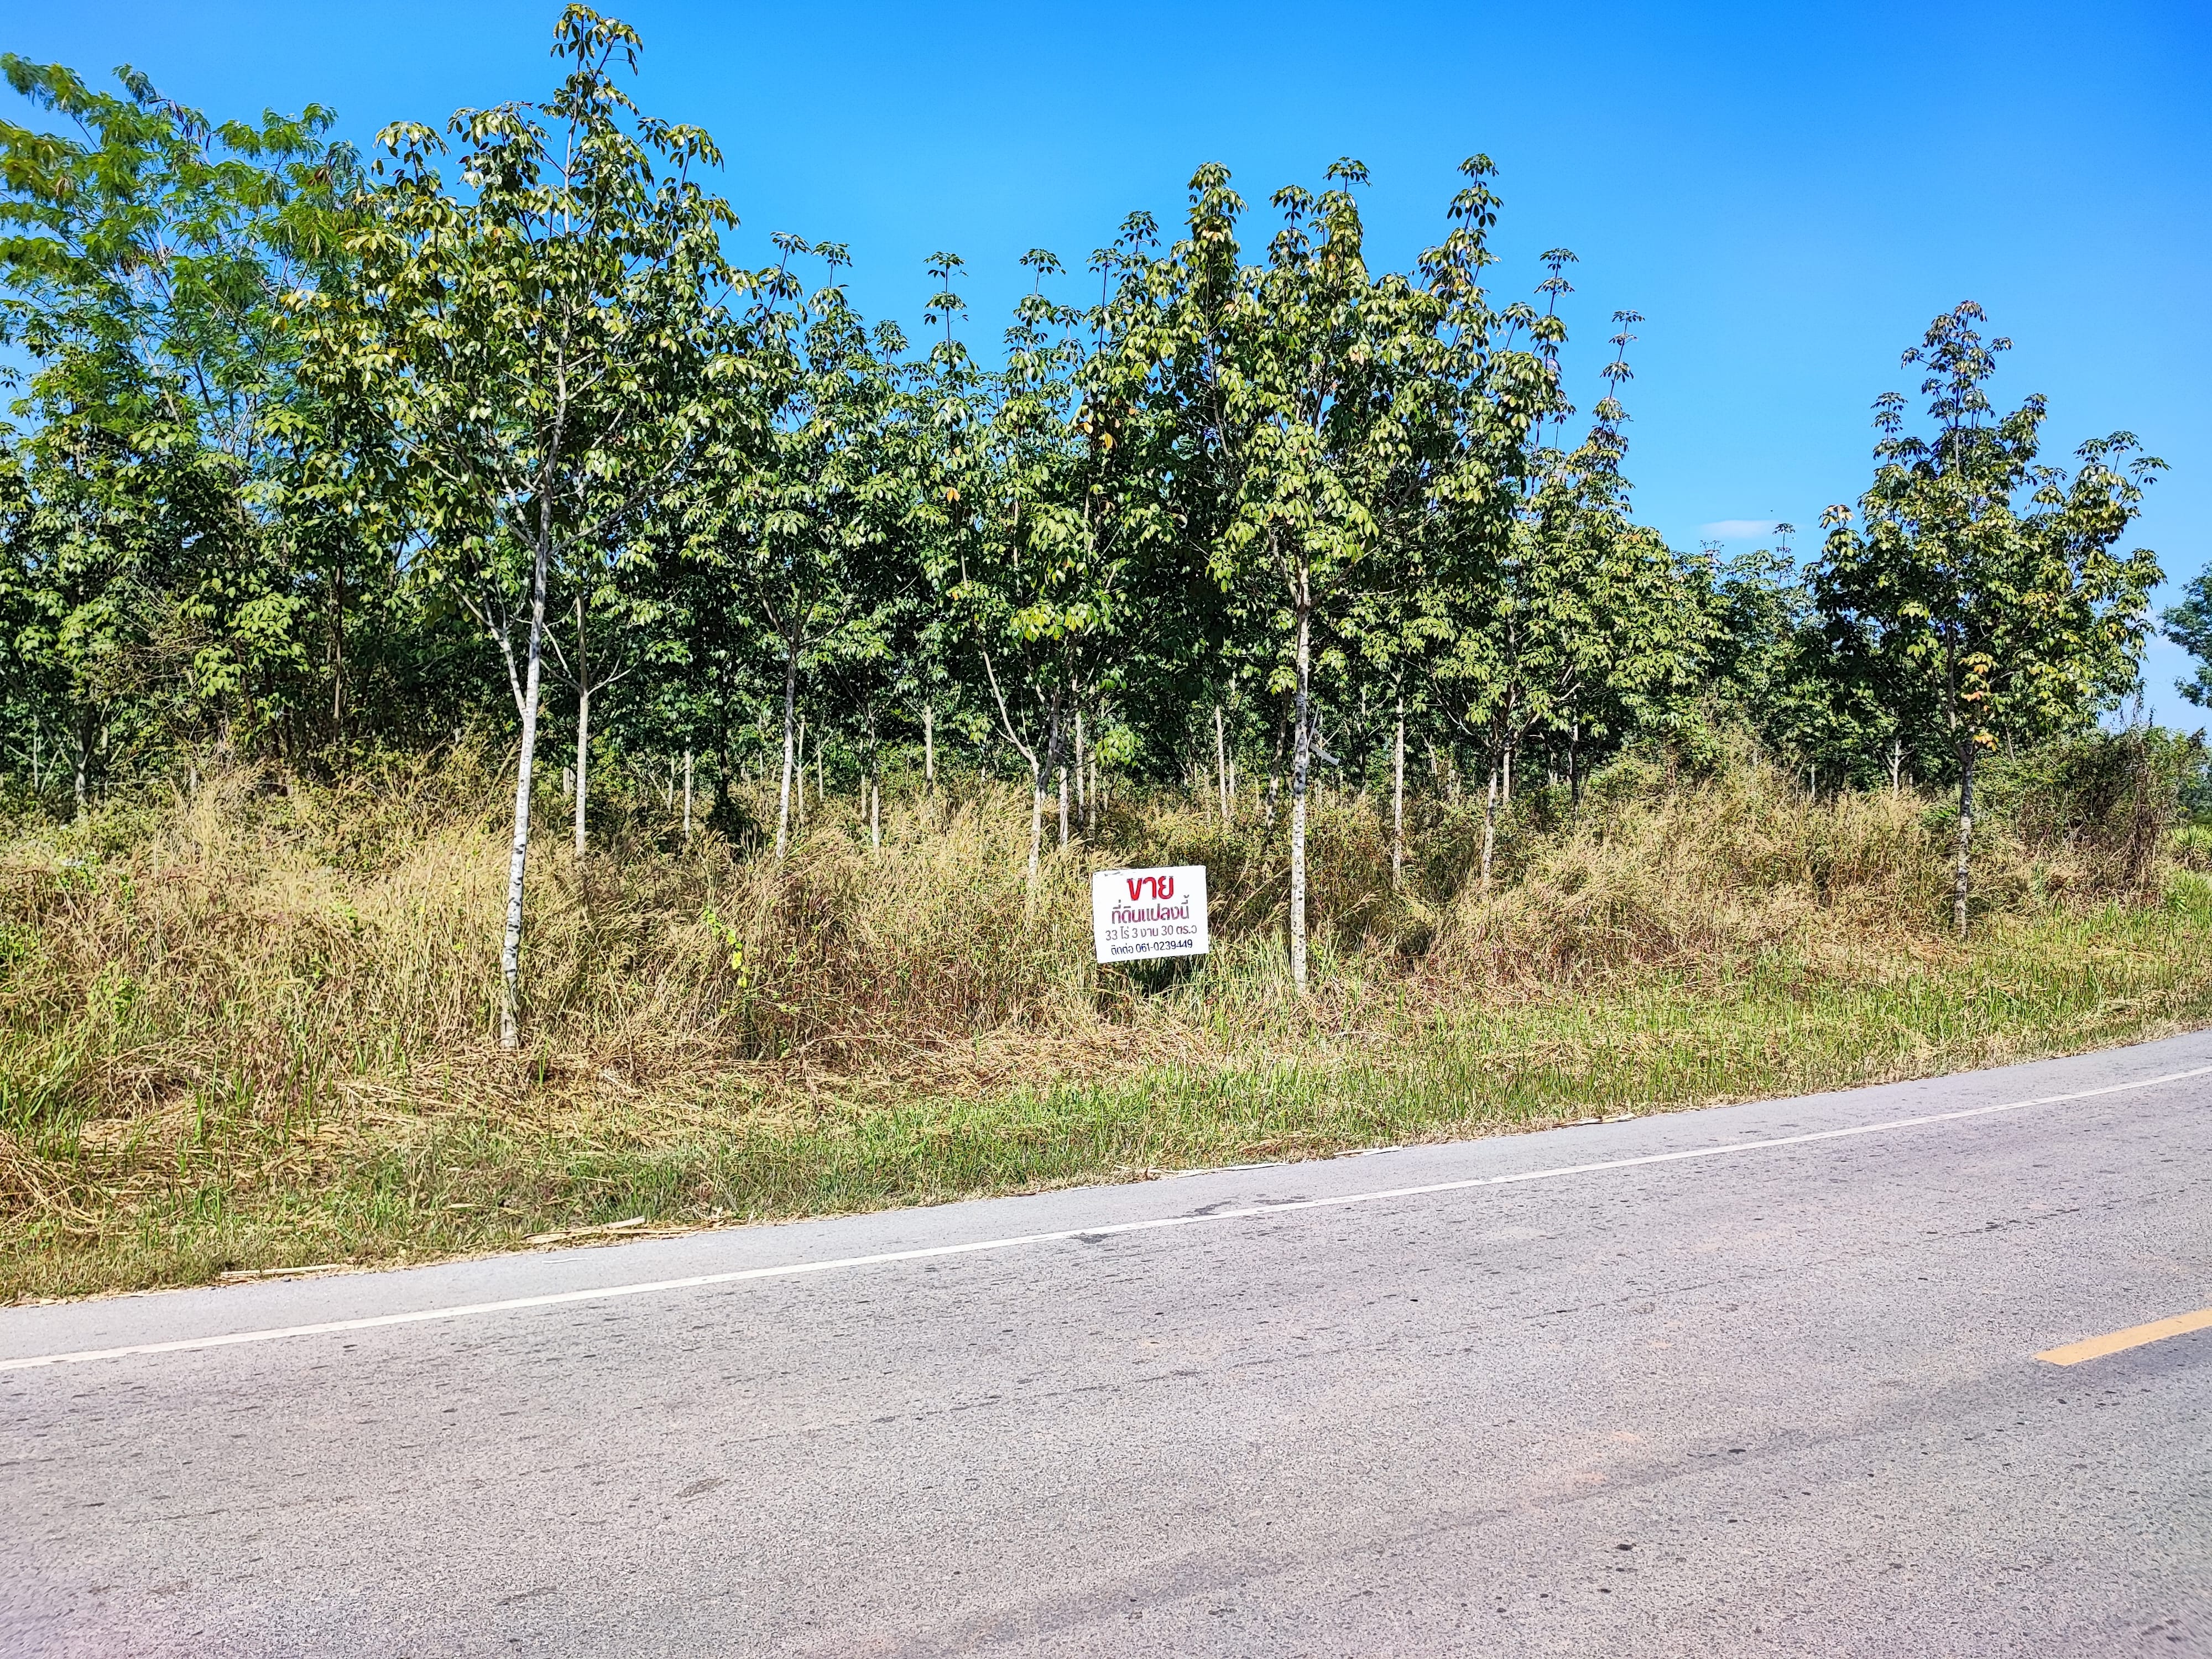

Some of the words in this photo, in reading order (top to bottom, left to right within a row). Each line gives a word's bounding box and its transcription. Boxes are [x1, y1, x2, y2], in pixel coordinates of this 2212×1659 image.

[1126, 876, 1173, 901] ขาย
[1112, 895, 1190, 924] ที่ดินแปลงนี้
[1105, 930, 1118, 941] 33
[1120, 926, 1129, 939] ไร่
[1131, 928, 1138, 938] 3
[1140, 927, 1159, 937] งาน
[1161, 925, 1173, 936] 30
[1111, 943, 1134, 955] ติดต่อ
